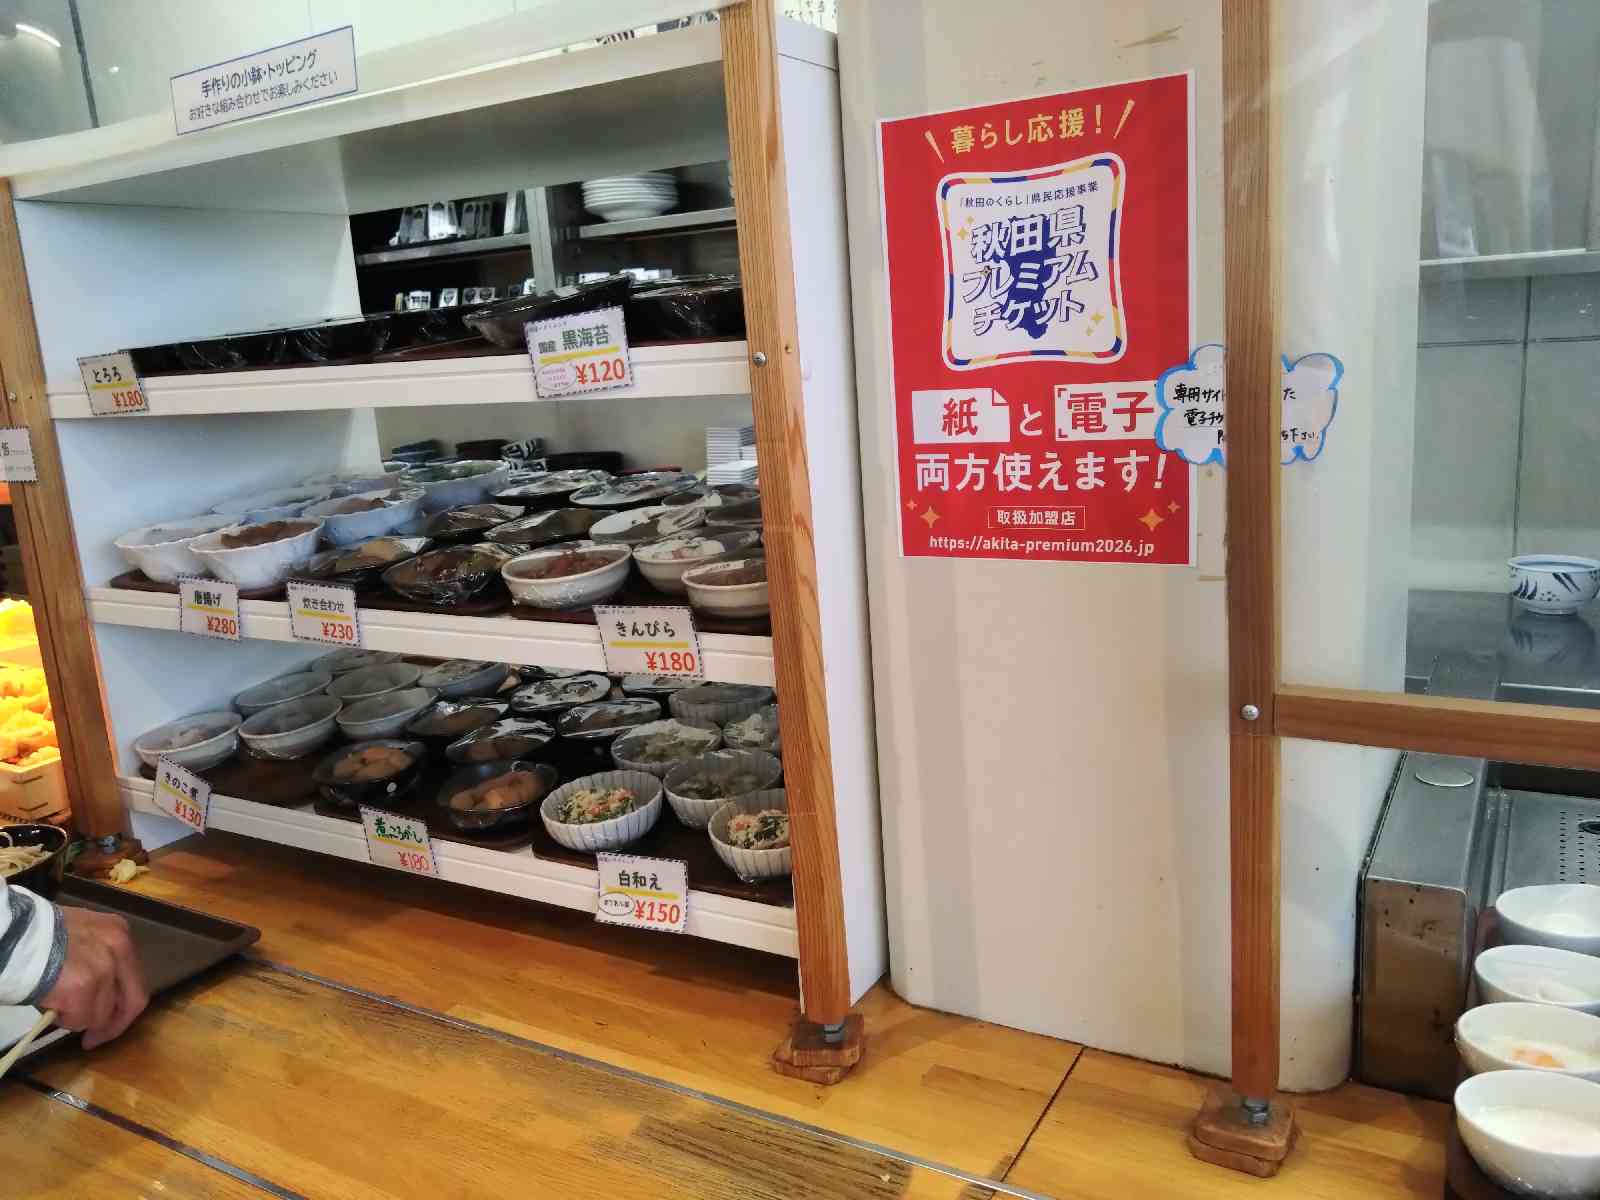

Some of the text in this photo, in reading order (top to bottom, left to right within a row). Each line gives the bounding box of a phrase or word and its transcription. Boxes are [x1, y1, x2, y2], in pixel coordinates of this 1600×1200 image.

[951, 104, 1102, 154] 暮らし応援！
[970, 205, 1086, 264] 秋田県
[962, 250, 1099, 304] プレミアム
[973, 290, 1086, 336] チケット
[562, 324, 609, 350] 黒海苔
[93, 366, 122, 383] とろろ
[576, 358, 625, 384] ¥120
[112, 391, 144, 406] ¥180
[942, 391, 1154, 436] 紙 と 電子
[915, 450, 1167, 492] 両方使えます!
[996, 509, 1076, 527] 取扱加盟店
[929, 535, 1155, 557] https://akita-premium2026.jp
[303, 597, 345, 613] 炊き合わせ
[207, 615, 236, 635] ¥280
[322, 622, 353, 640] ¥230
[616, 620, 676, 637] きんぴら
[645, 652, 695, 671] ¥180
[619, 870, 662, 890] 白和え
[635, 899, 681, 924] ¥150
